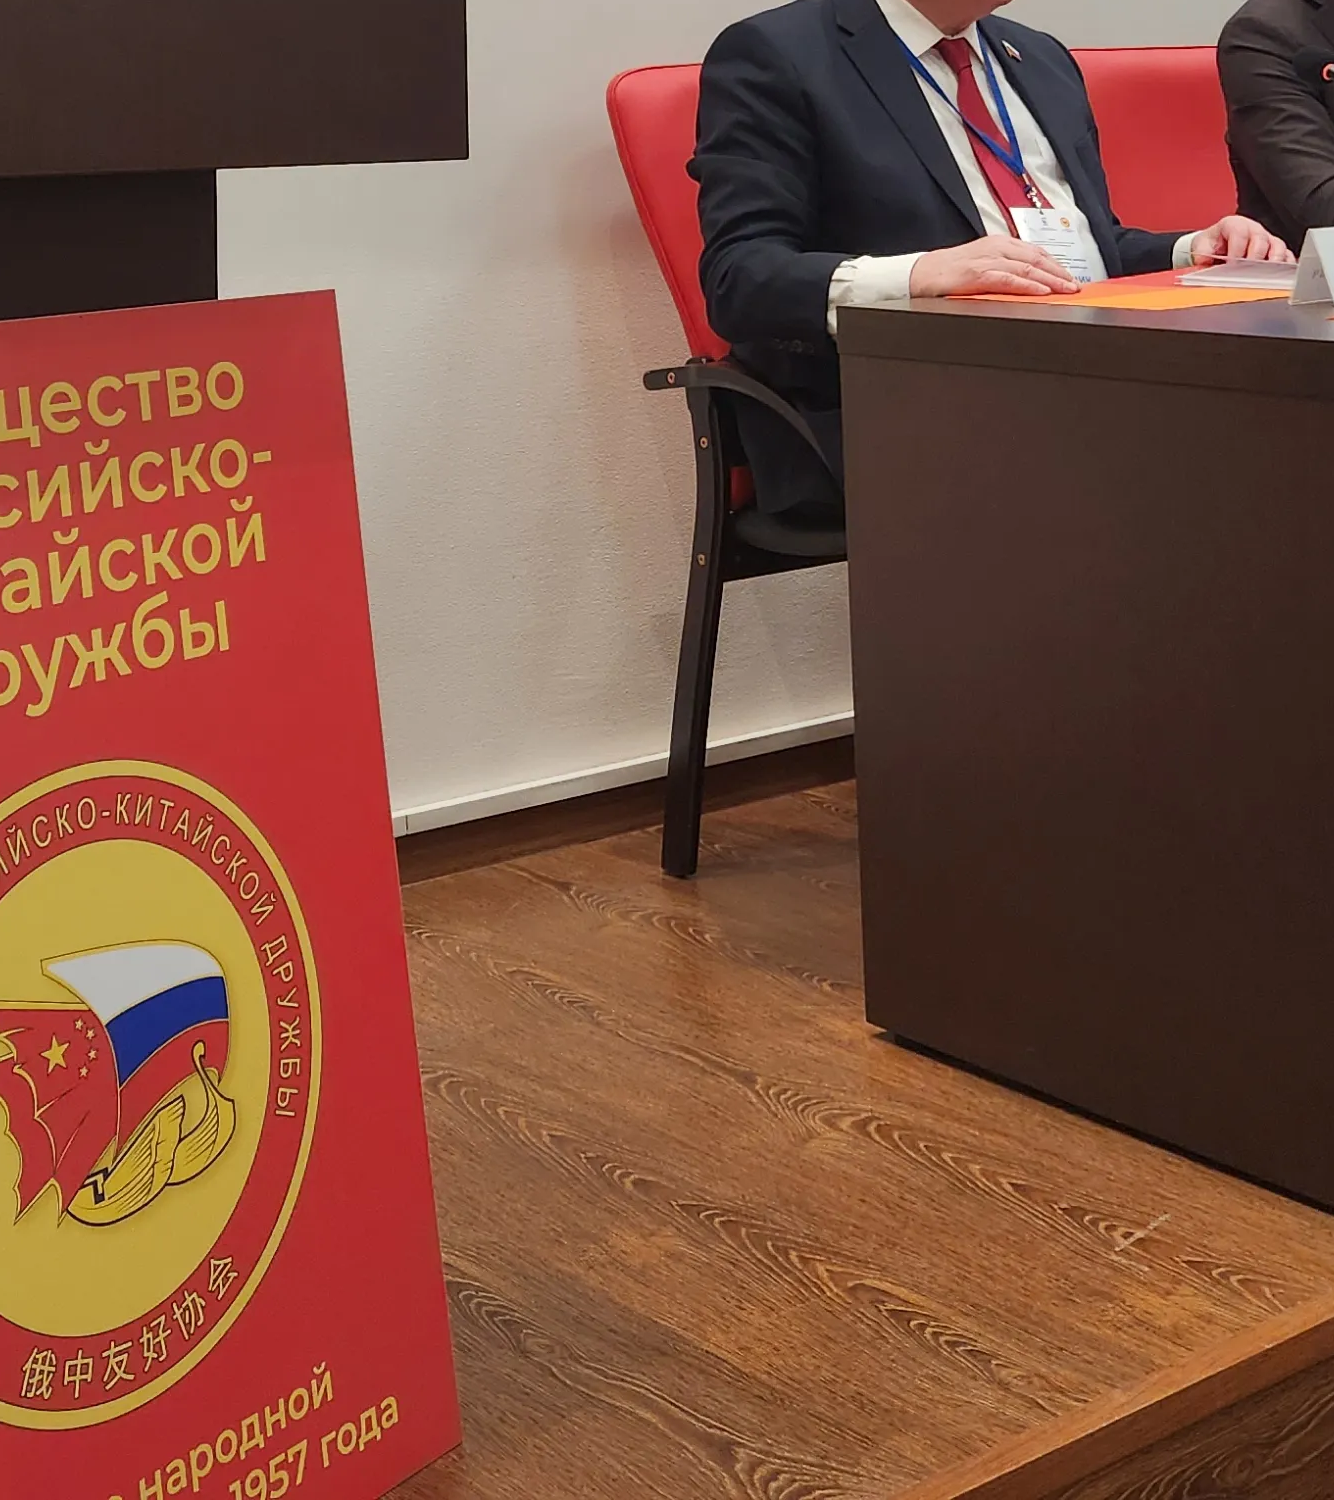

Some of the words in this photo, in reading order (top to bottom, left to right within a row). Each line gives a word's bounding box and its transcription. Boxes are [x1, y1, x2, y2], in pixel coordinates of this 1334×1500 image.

[261, 935, 305, 1121] ДРУЖБЫ
[18, 1253, 243, 1402] 俄中友好协会
[138, 1361, 334, 1500] народной
[228, 1438, 309, 1500] 1957
[319, 1395, 399, 1468] года
